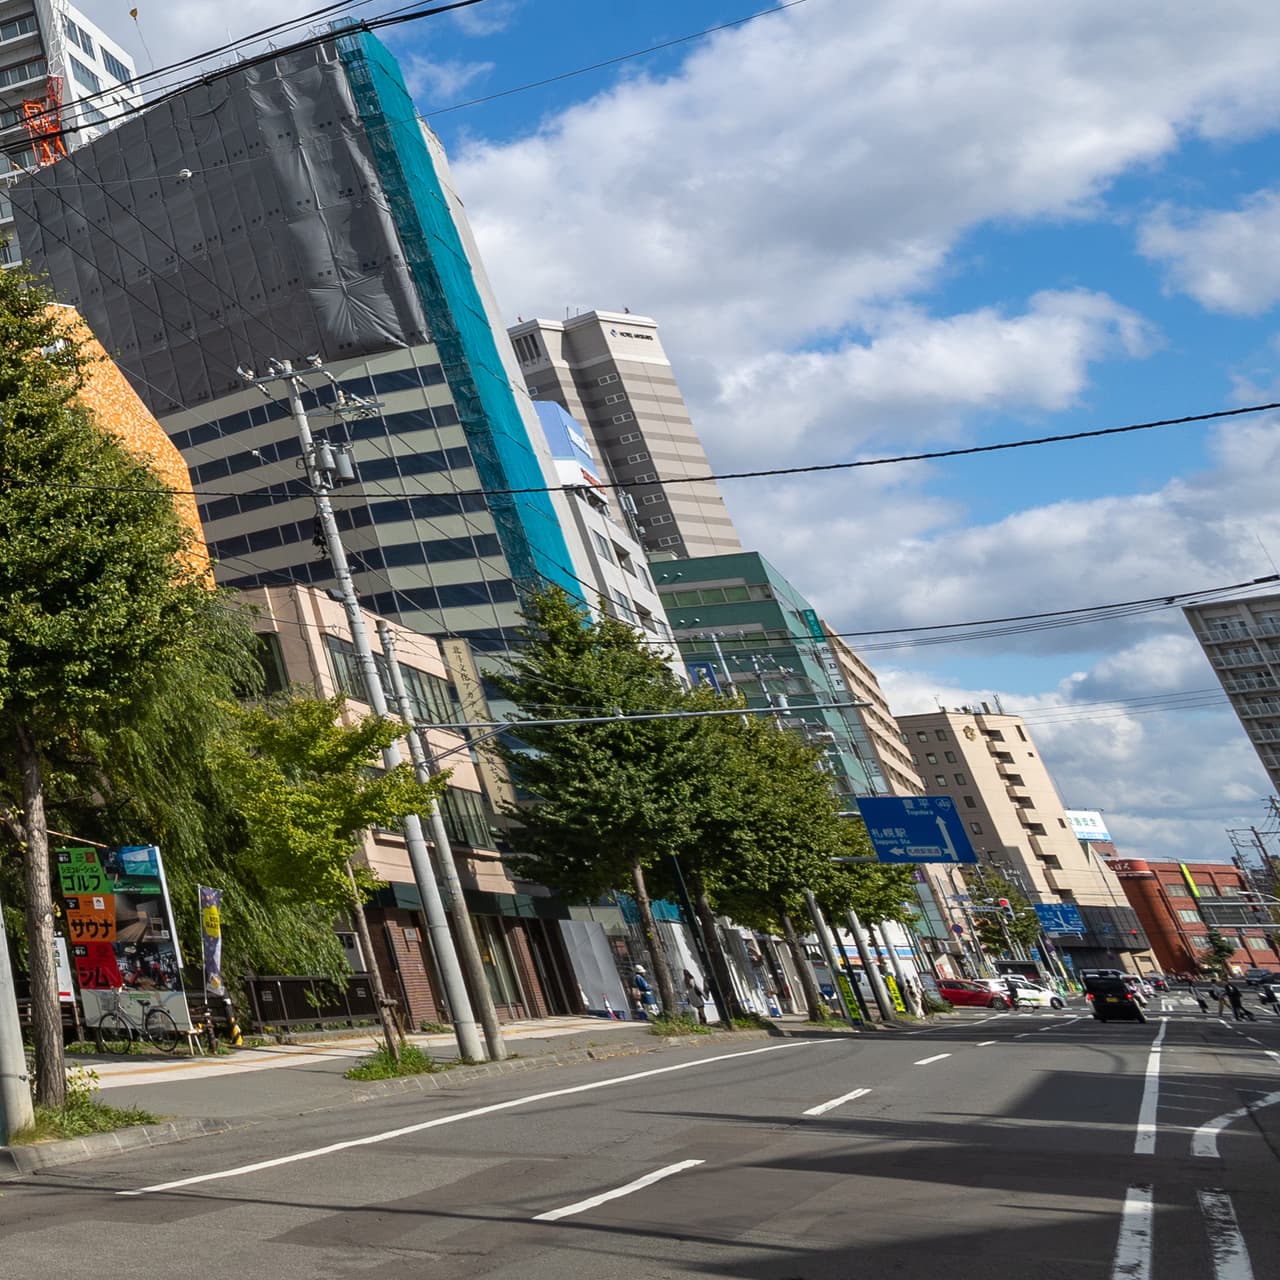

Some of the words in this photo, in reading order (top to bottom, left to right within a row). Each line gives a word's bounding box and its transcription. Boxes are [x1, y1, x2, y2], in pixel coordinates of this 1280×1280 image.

[62, 874, 101, 891] ゴルフ
[71, 919, 113, 938] サウナ
[79, 966, 110, 987] ジム
